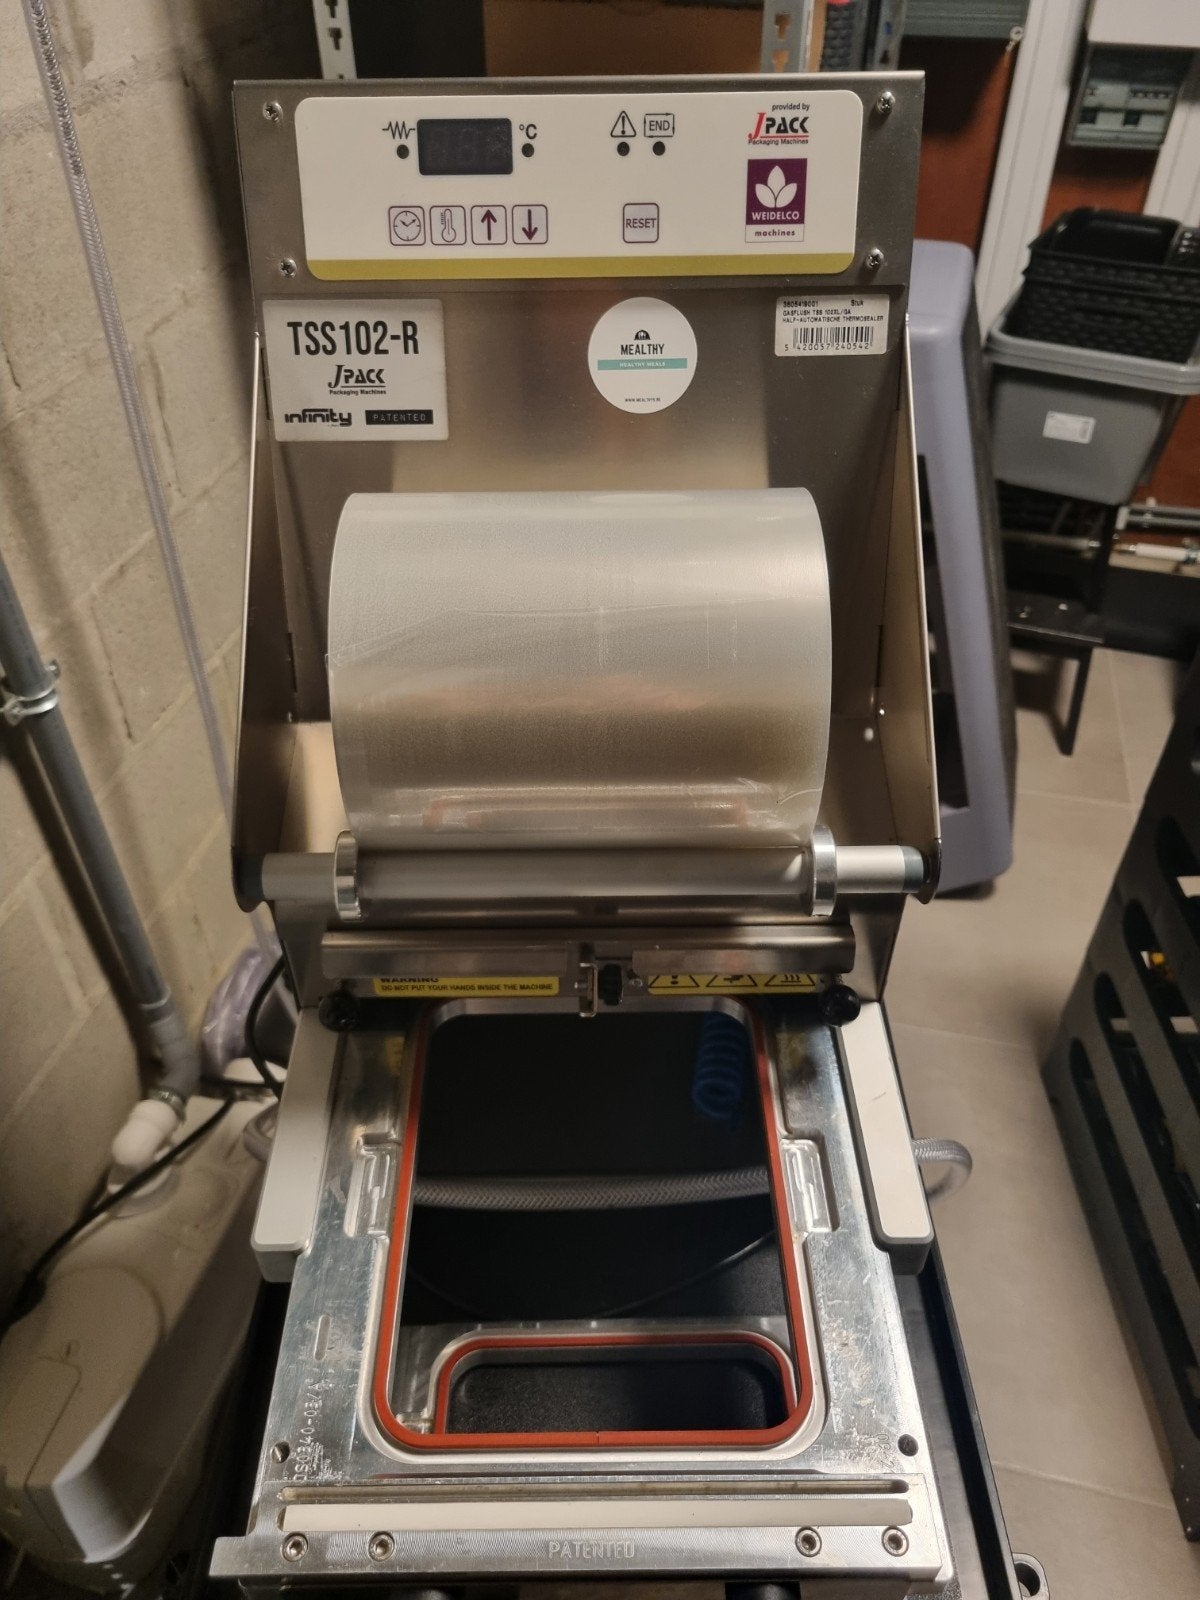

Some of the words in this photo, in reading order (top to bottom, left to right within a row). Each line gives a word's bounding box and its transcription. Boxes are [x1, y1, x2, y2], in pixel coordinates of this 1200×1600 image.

[772, 103, 800, 112] provided
[802, 103, 810, 112] by
[519, 123, 538, 140] °C
[649, 120, 671, 132] END
[748, 138, 779, 146] Packaging
[751, 210, 800, 221] WEIDELCO
[625, 218, 656, 229] RESET
[755, 229, 796, 237] machines
[783, 309, 811, 317] GASFLUSH
[782, 316, 841, 324] HALF-AUTOMATISCHE
[286, 319, 420, 356] TSS102-R
[620, 343, 665, 356] MEALTHY
[796, 343, 831, 351] 420057
[835, 343, 869, 351] 240542
[329, 388, 359, 397] Packaging
[360, 388, 387, 396] Machines
[284, 408, 353, 428] infinity
[372, 412, 426, 423] PATENTED
[548, 1540, 635, 1559] PATENTED
